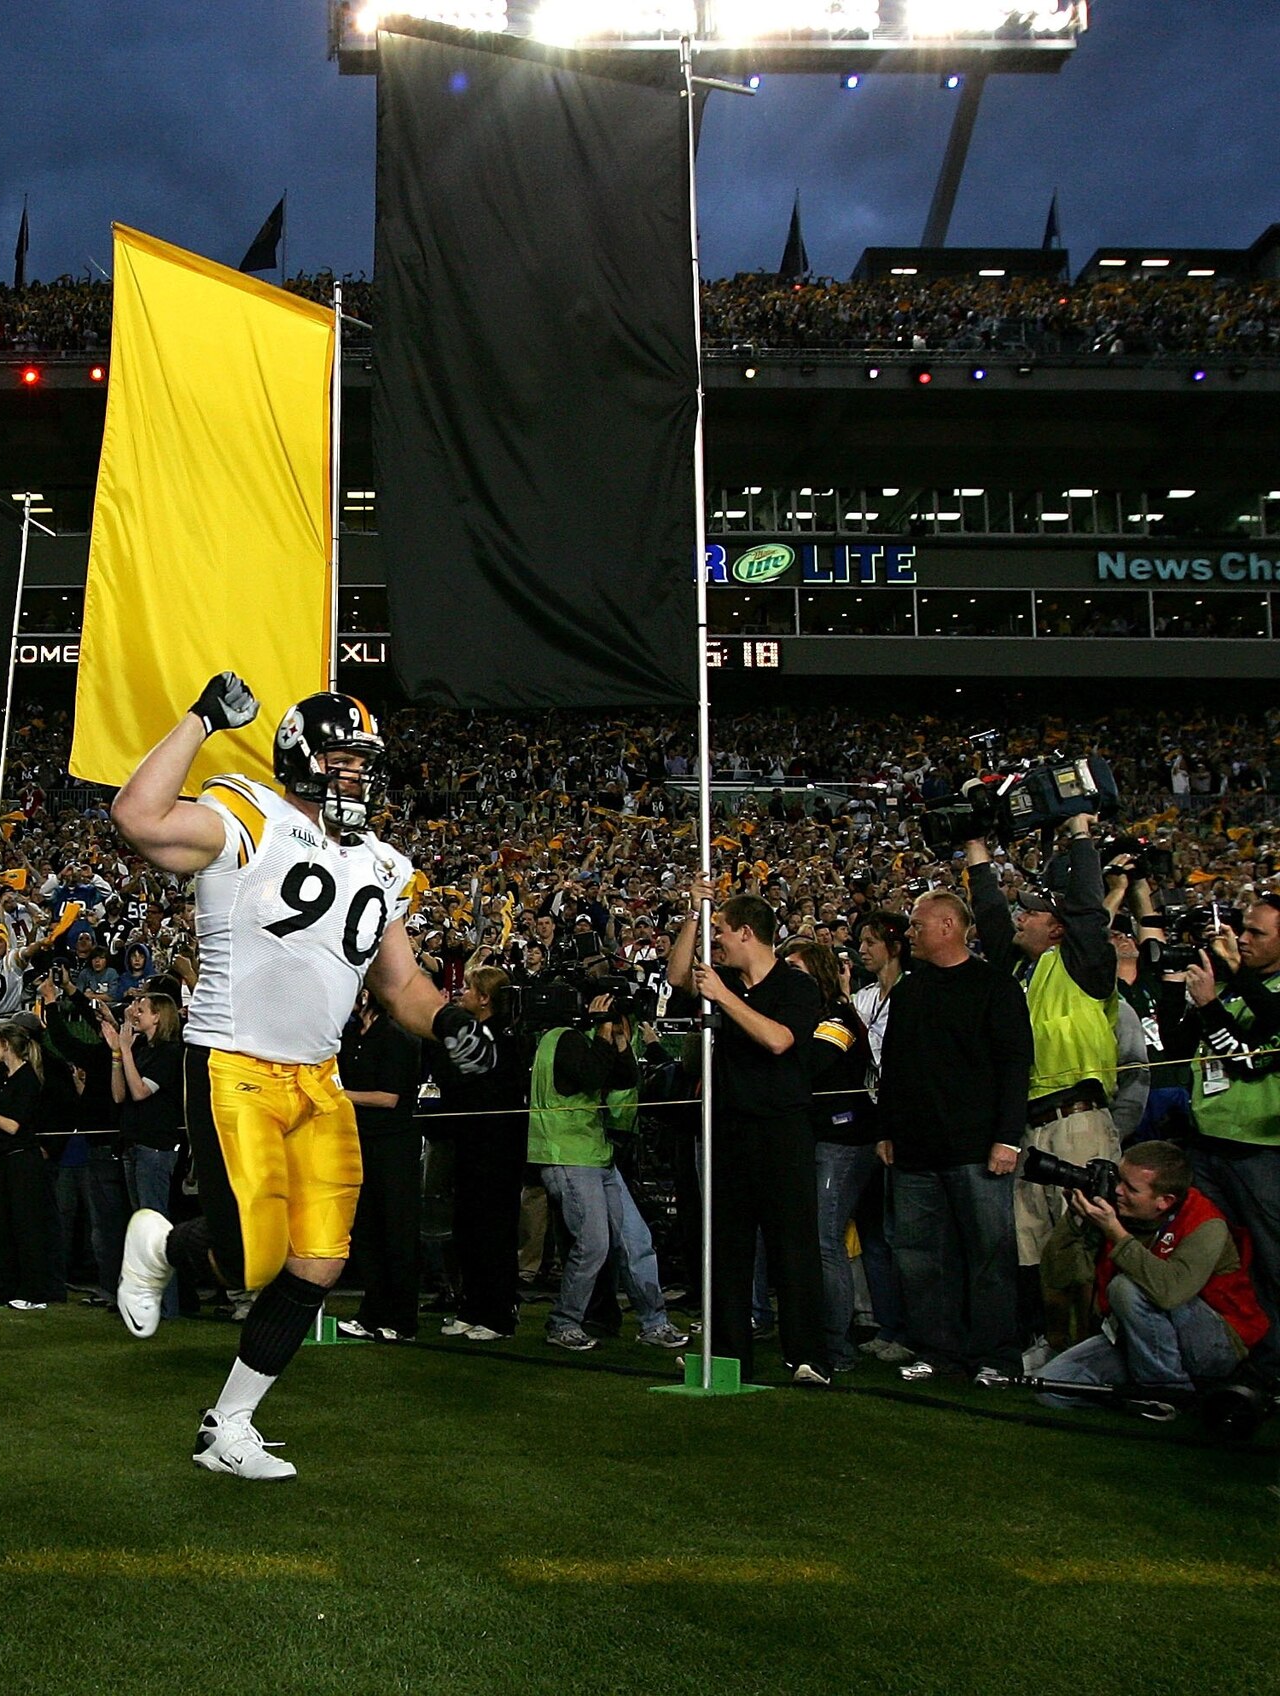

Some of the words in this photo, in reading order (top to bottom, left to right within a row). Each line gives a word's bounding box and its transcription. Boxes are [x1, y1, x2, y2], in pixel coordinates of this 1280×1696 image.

[746, 554, 785, 579] Lite
[803, 545, 917, 583] LITE
[1098, 552, 1214, 580] News
[1220, 552, 1280, 581] Ch
[15, 645, 80, 663] OME
[262, 861, 388, 966] 90
